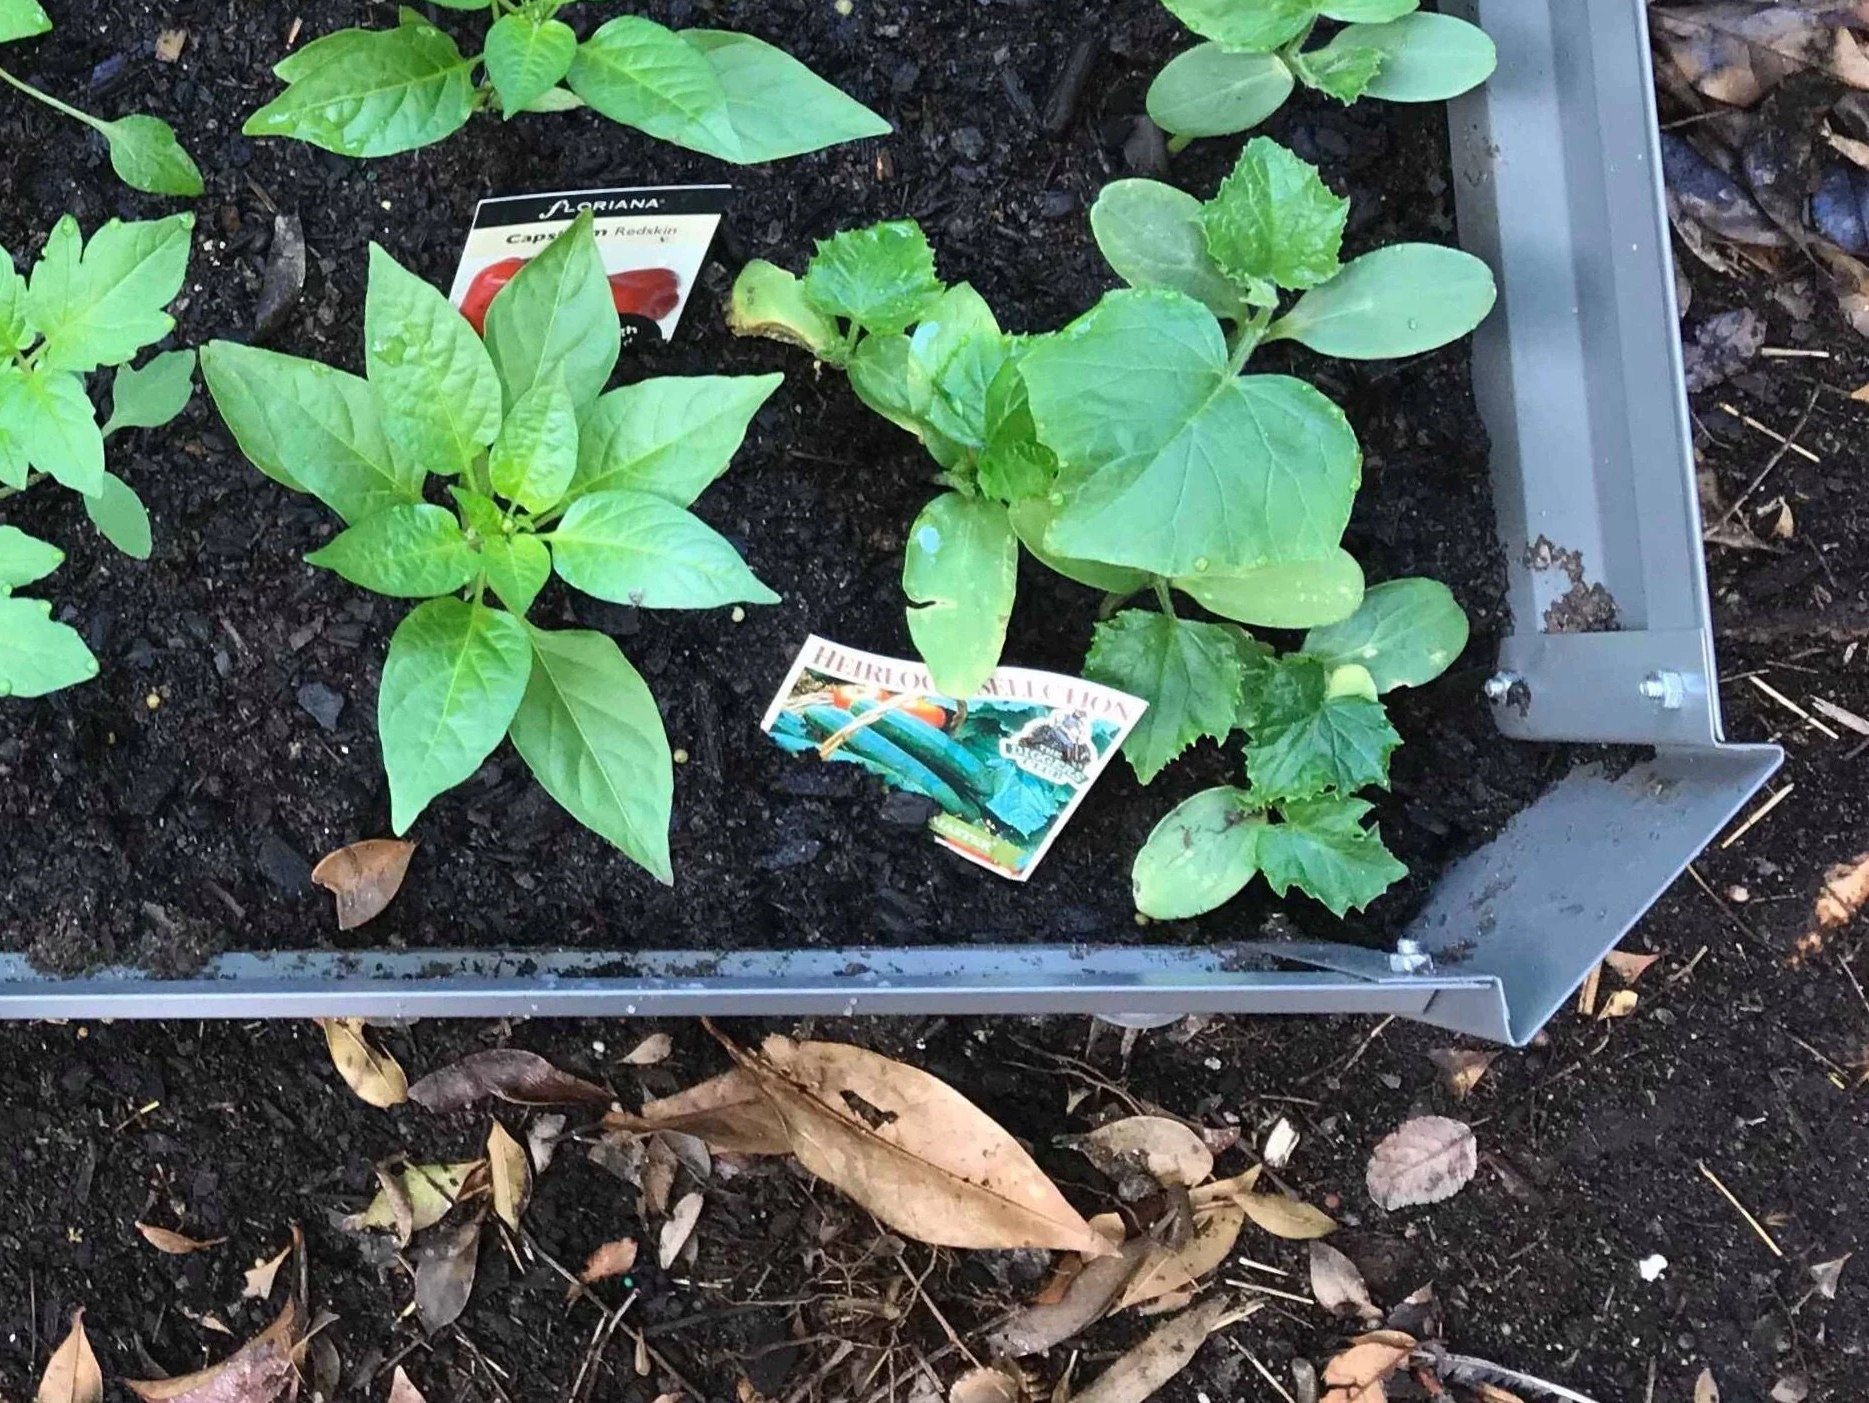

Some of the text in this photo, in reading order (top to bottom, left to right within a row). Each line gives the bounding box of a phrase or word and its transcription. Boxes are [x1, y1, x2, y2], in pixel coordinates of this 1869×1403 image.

[506, 225, 678, 244] Capsm Redskin
[813, 645, 930, 691] HEIRLO
